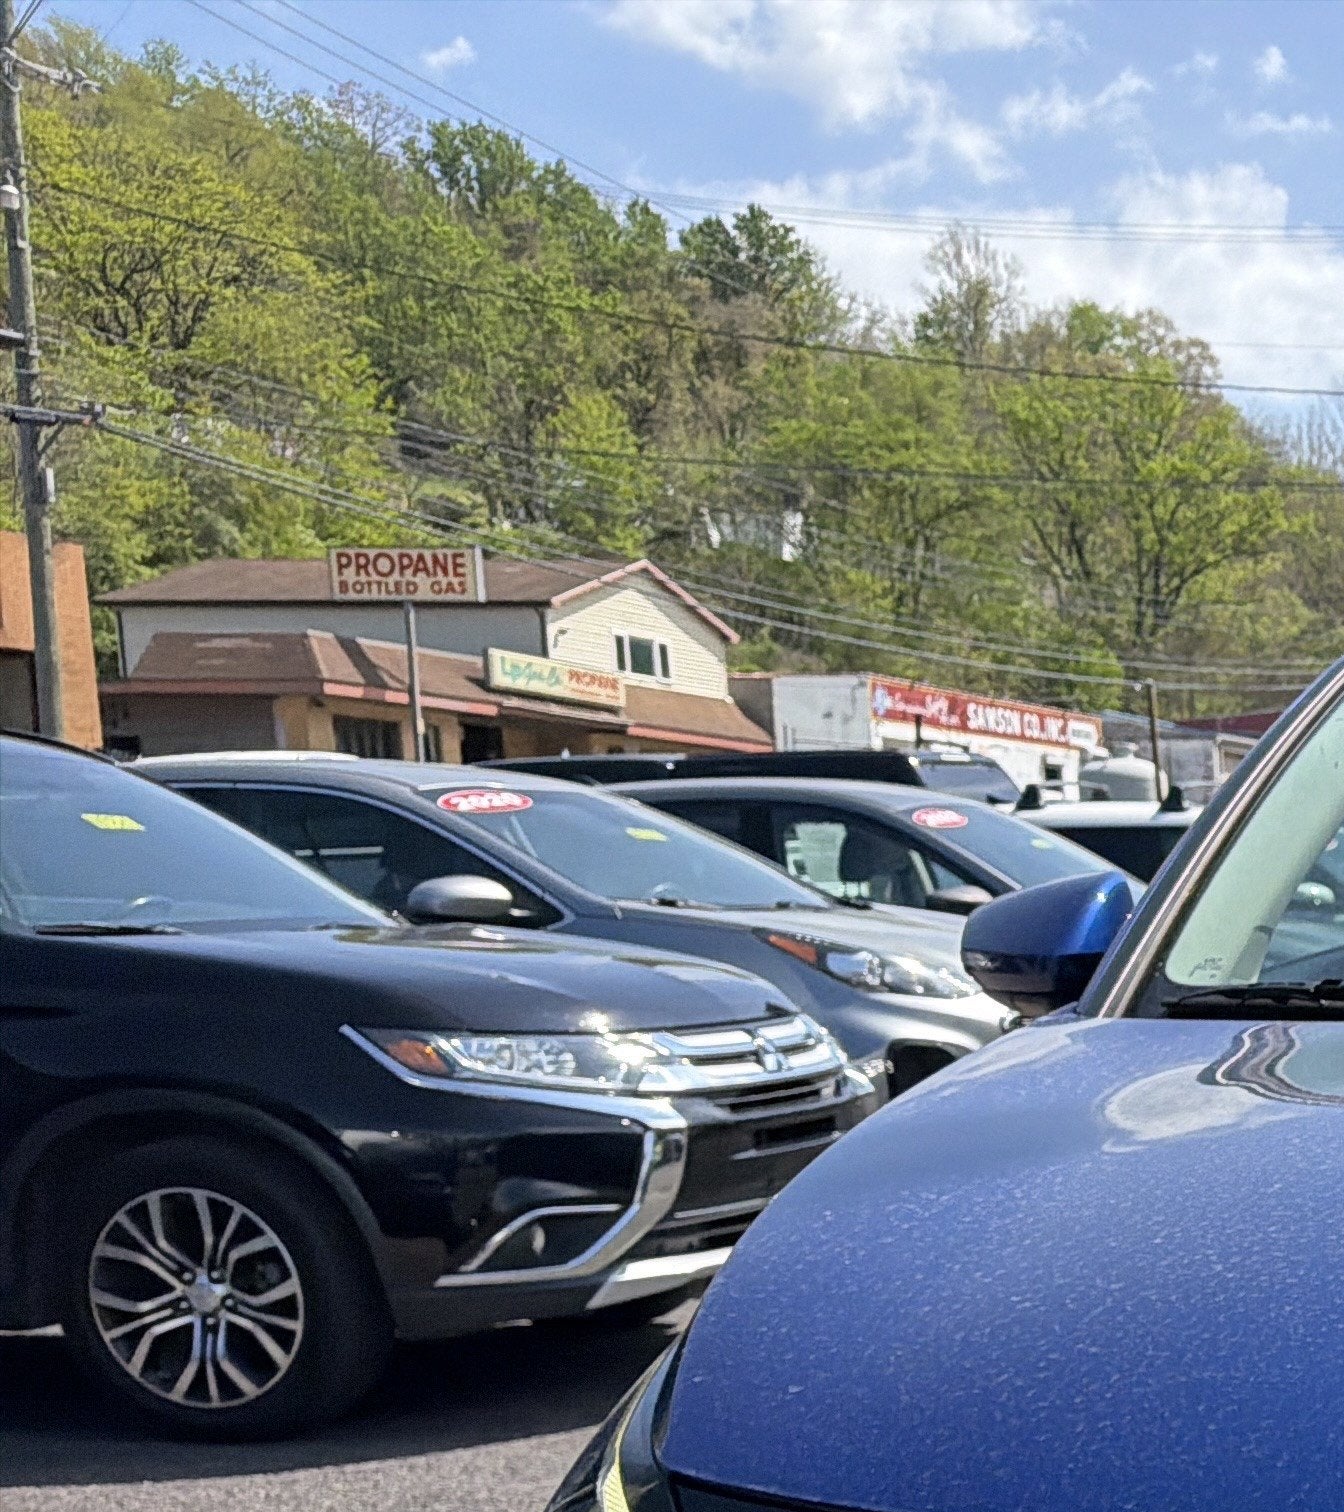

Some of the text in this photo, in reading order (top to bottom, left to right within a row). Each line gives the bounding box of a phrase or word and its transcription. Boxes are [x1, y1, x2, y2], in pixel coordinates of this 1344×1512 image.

[336, 552, 467, 578] PROPANE
[338, 580, 467, 595] BOTTLED GAS
